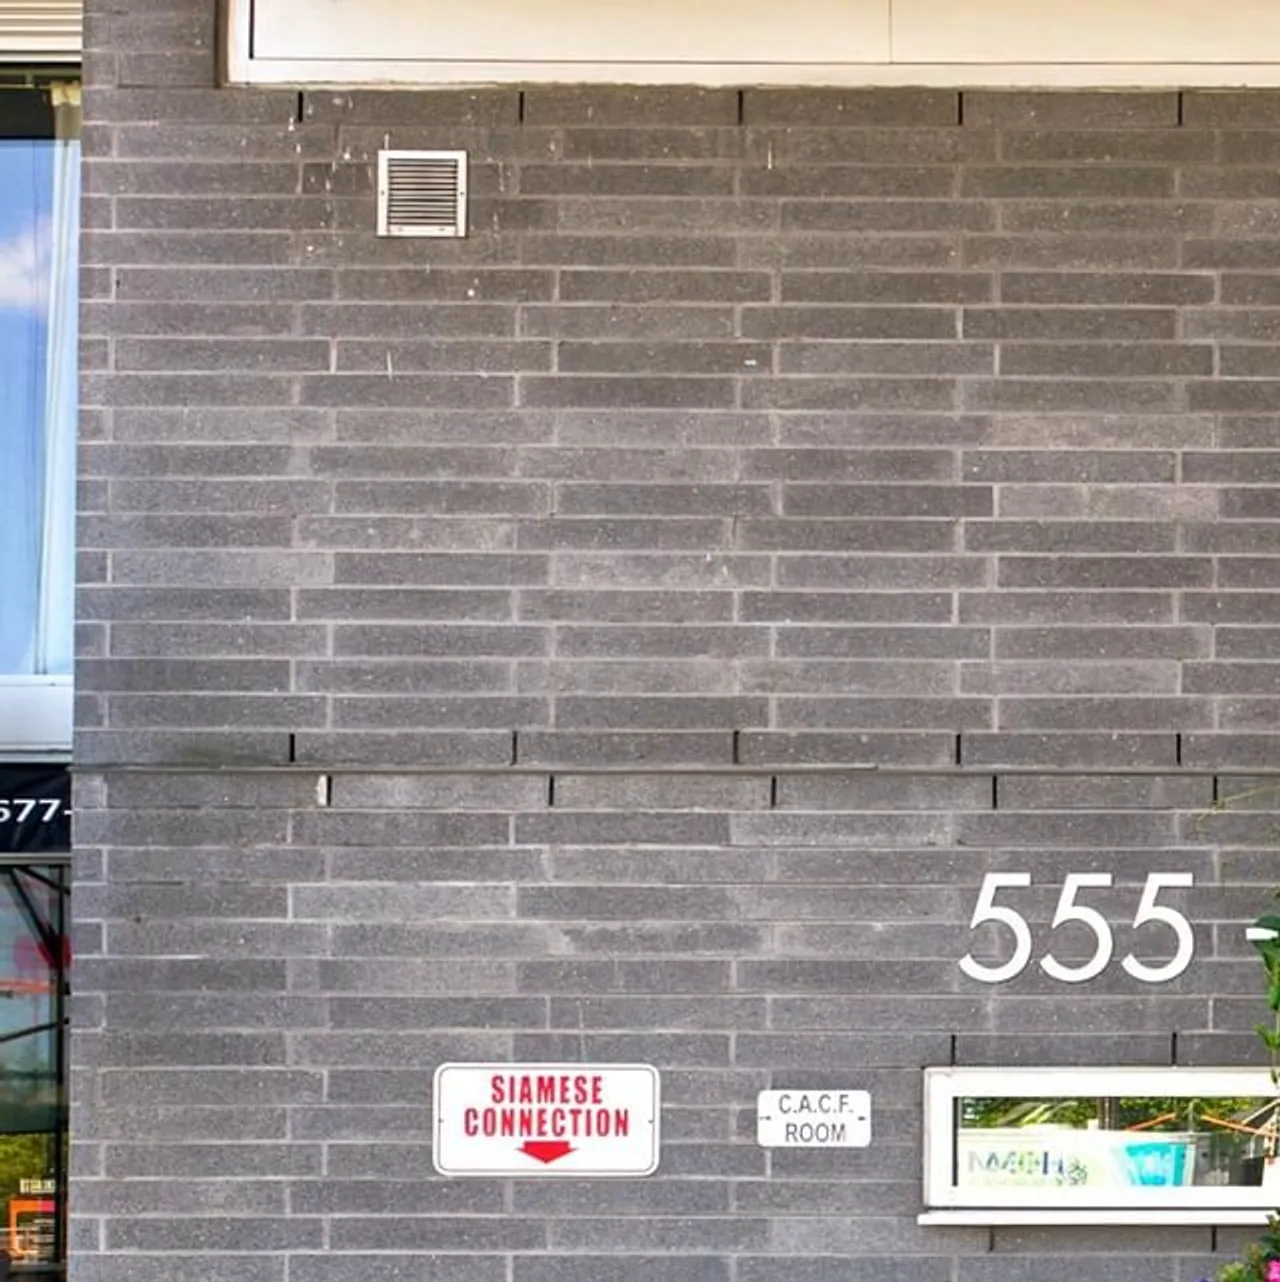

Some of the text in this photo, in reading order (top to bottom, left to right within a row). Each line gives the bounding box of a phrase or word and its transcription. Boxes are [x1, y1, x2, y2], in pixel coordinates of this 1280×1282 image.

[958, 872, 1195, 983] 555
[491, 1075, 603, 1104] SIAMESE
[778, 1093, 854, 1114] C.A.C.F.
[464, 1108, 629, 1137] CONNECTION
[785, 1122, 847, 1142] ROOM
